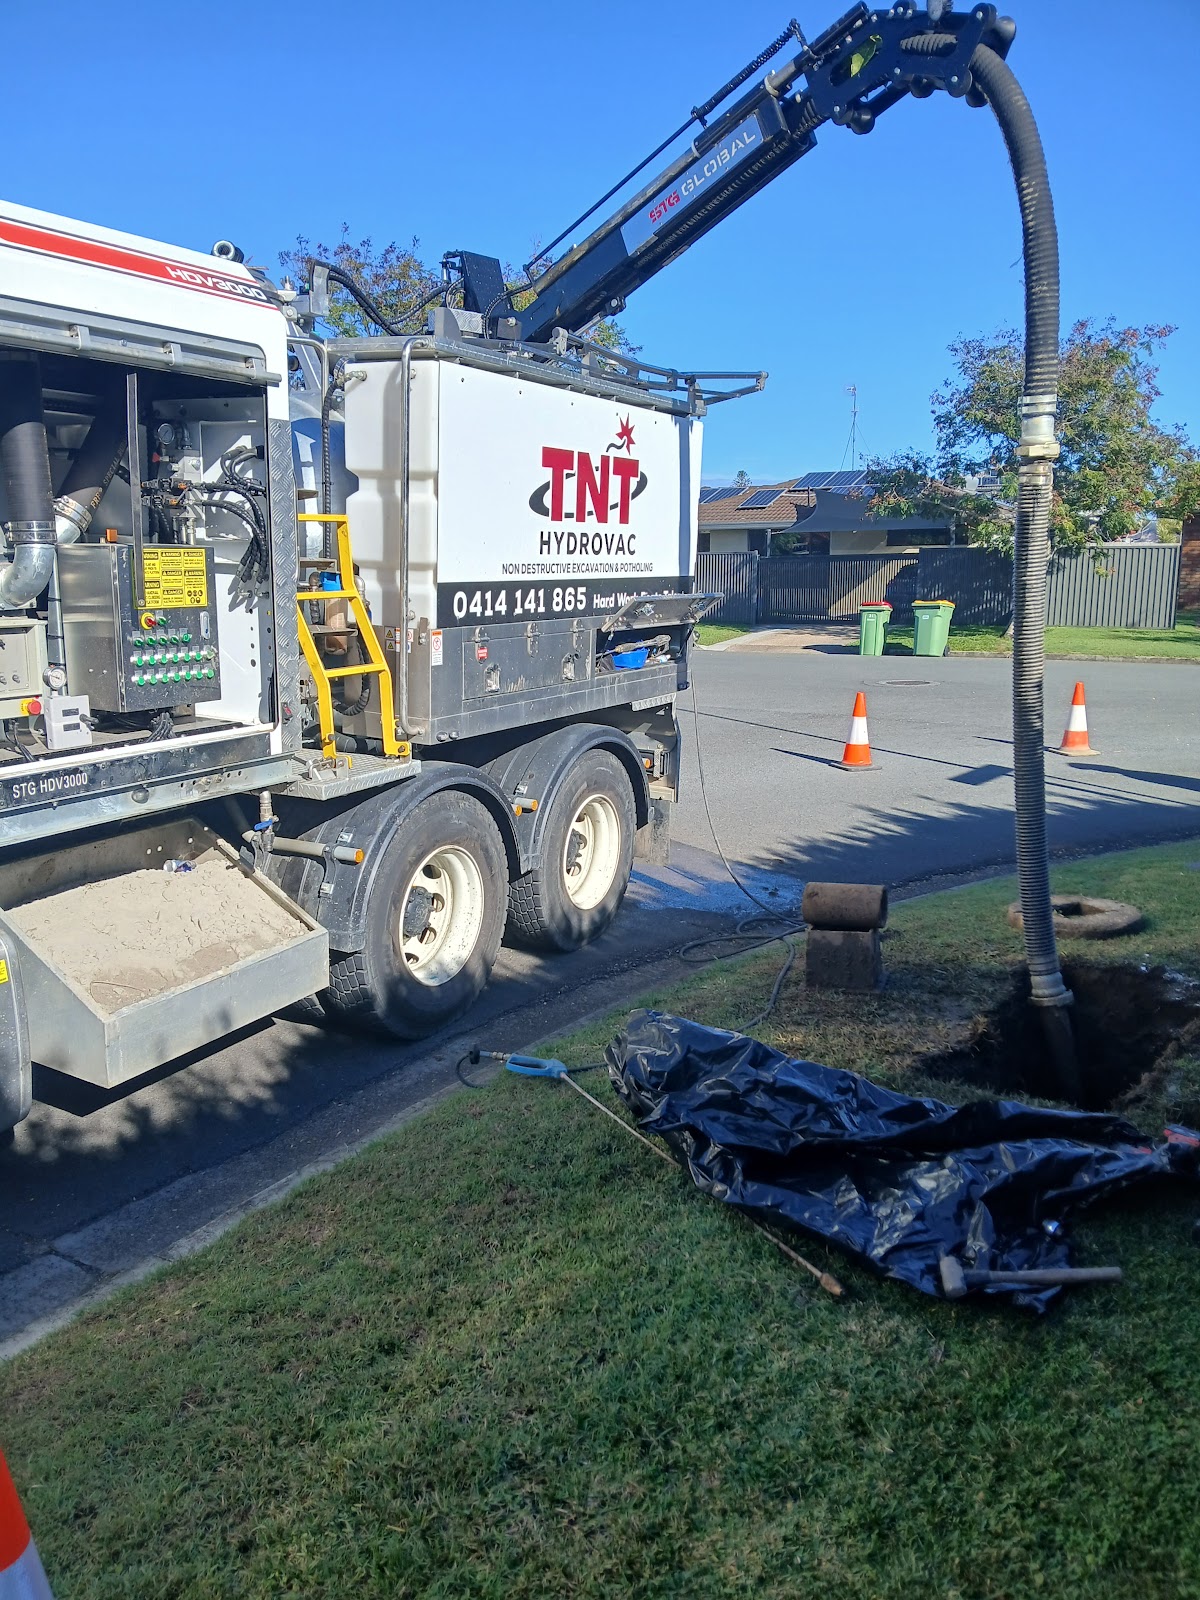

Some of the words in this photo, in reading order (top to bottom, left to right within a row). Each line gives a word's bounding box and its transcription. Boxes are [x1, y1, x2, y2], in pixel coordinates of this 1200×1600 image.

[649, 189, 681, 224] STG
[681, 131, 756, 196] GLOBAL
[165, 266, 268, 300] HDV3000
[541, 446, 640, 524] TNT
[540, 531, 636, 555] HYDROVAC
[502, 563, 520, 575] NON
[521, 563, 571, 575] DESTRUCTIVE
[572, 562, 614, 574] EXCAVATION
[614, 562, 619, 573] &
[620, 562, 653, 573] POTHOLING
[453, 590, 507, 618] 0414
[514, 588, 545, 615] 141
[552, 586, 587, 612] 865
[593, 593, 614, 609] Hard
[12, 782, 36, 798] STG
[40, 773, 88, 793] HDV3000
